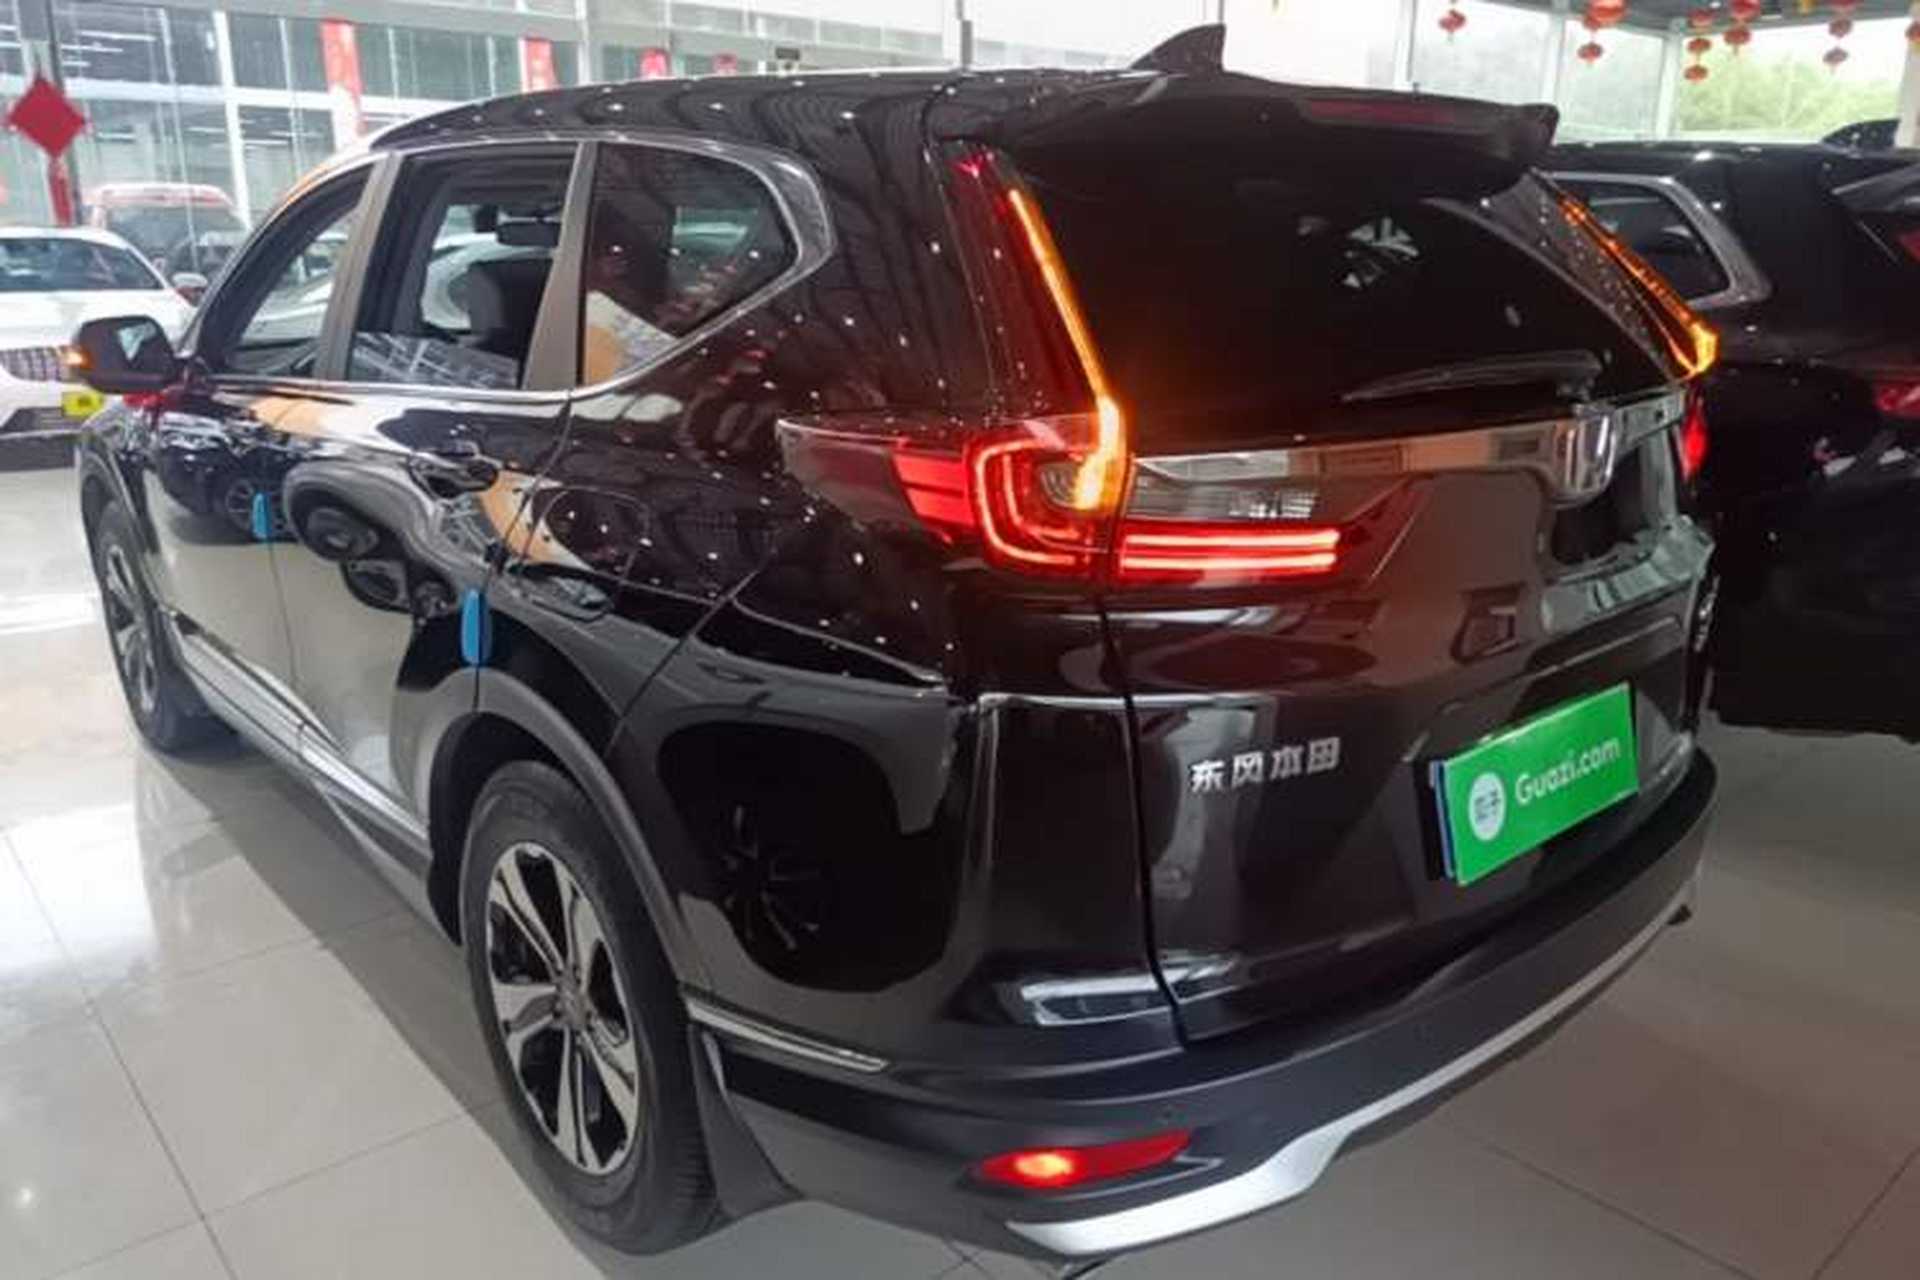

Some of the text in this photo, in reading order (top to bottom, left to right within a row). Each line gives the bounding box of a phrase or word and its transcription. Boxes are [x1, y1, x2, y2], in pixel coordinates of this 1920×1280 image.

[1191, 737, 1340, 792] 东风本田
[1515, 738, 1620, 805] Guazi.com
